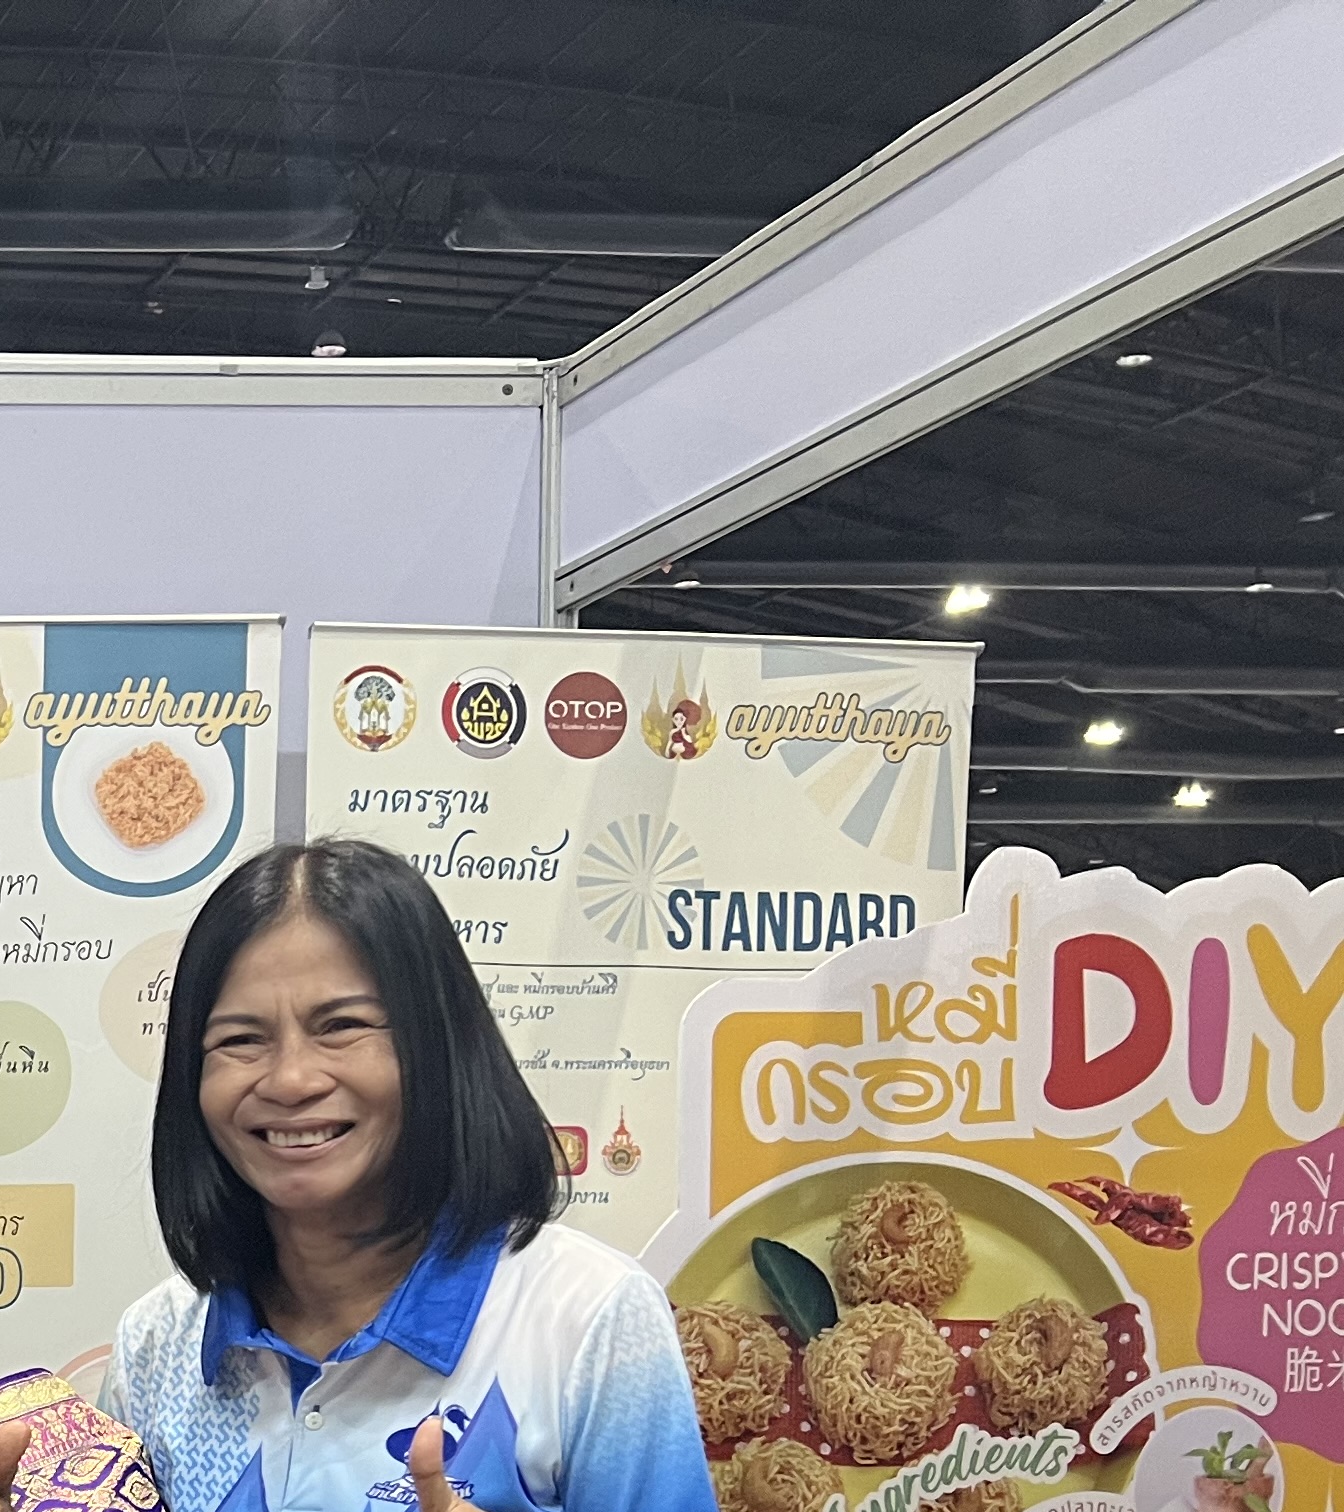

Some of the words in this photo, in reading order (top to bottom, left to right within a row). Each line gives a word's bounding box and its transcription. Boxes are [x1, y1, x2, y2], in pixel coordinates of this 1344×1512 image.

[24, 676, 272, 746] ayutthaya
[548, 700, 623, 719] OTOP
[726, 691, 951, 764] ayutthaya
[348, 786, 489, 829] มาตรฐาน
[873, 892, 1019, 1044] หมี่
[756, 1058, 1016, 1126] กรอบ
[1226, 1252, 1344, 1291] CRISP
